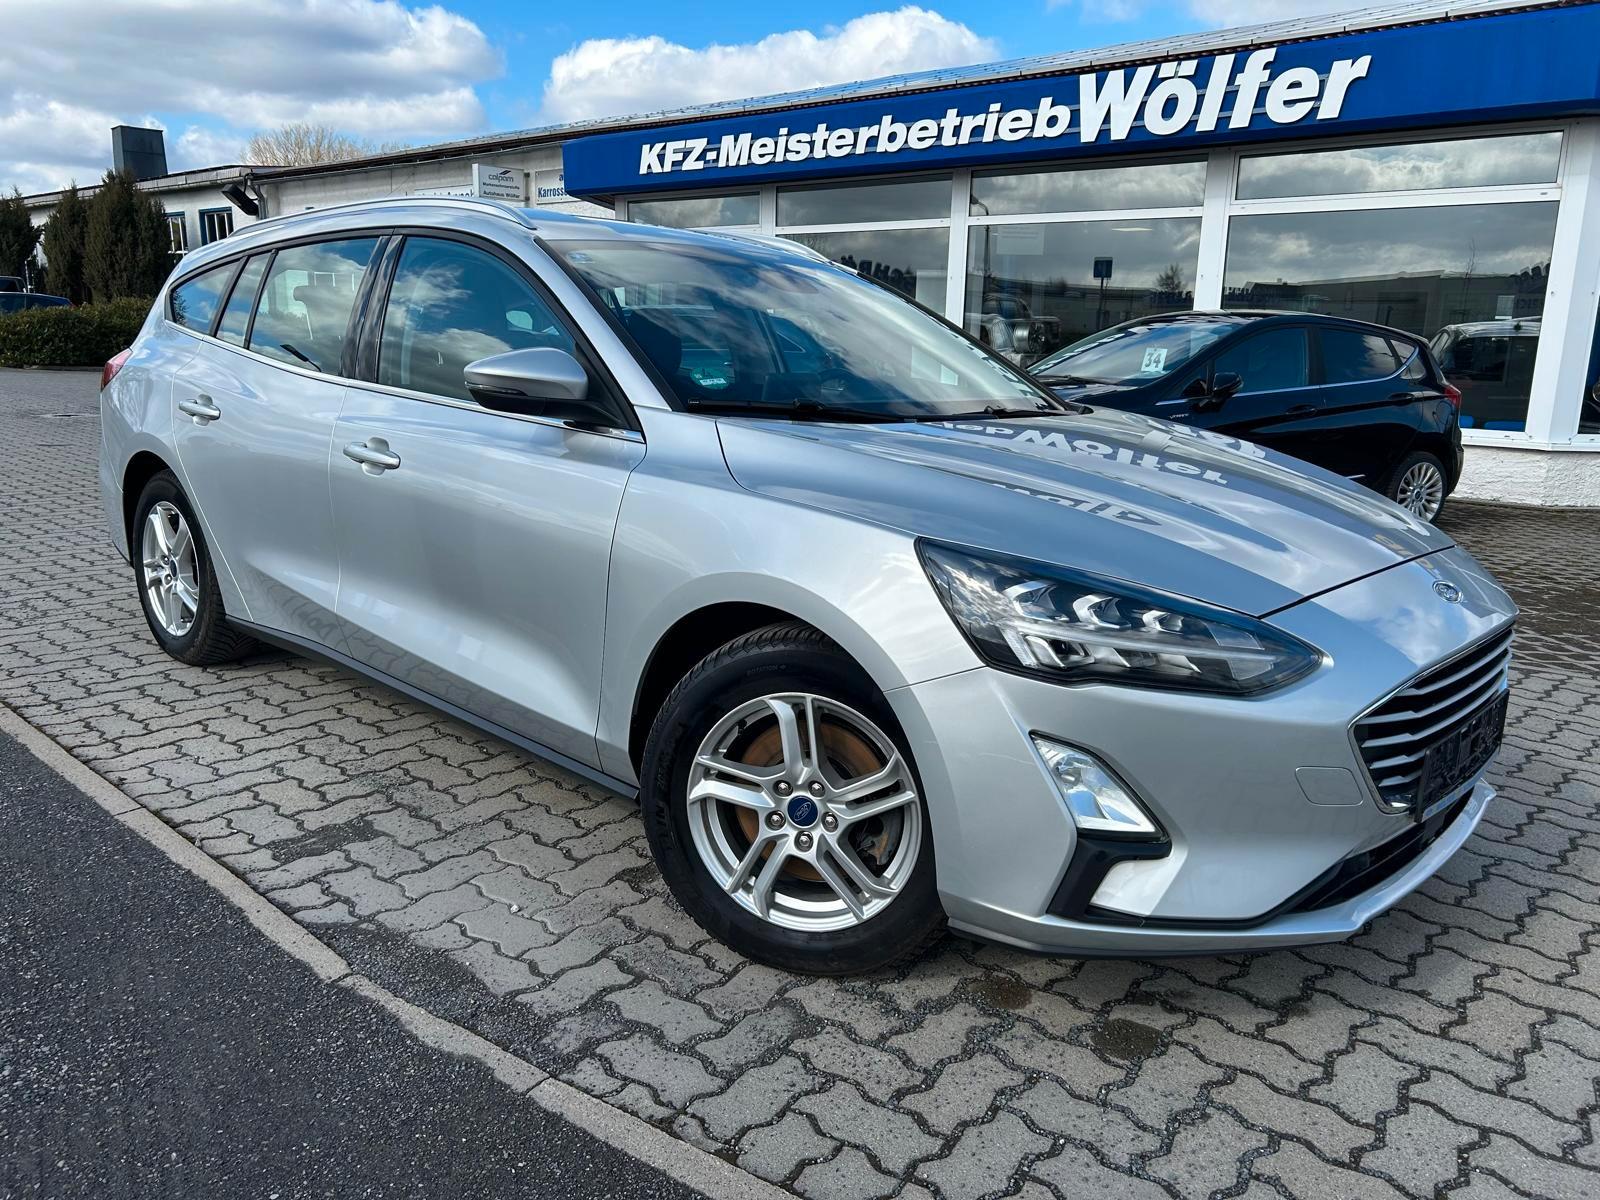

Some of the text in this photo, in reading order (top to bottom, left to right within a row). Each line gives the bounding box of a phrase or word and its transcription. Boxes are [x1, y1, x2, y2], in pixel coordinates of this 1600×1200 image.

[639, 47, 1372, 176] KFZ-Meisterbetrieb Wölfer
[1144, 352, 1162, 369] 34
